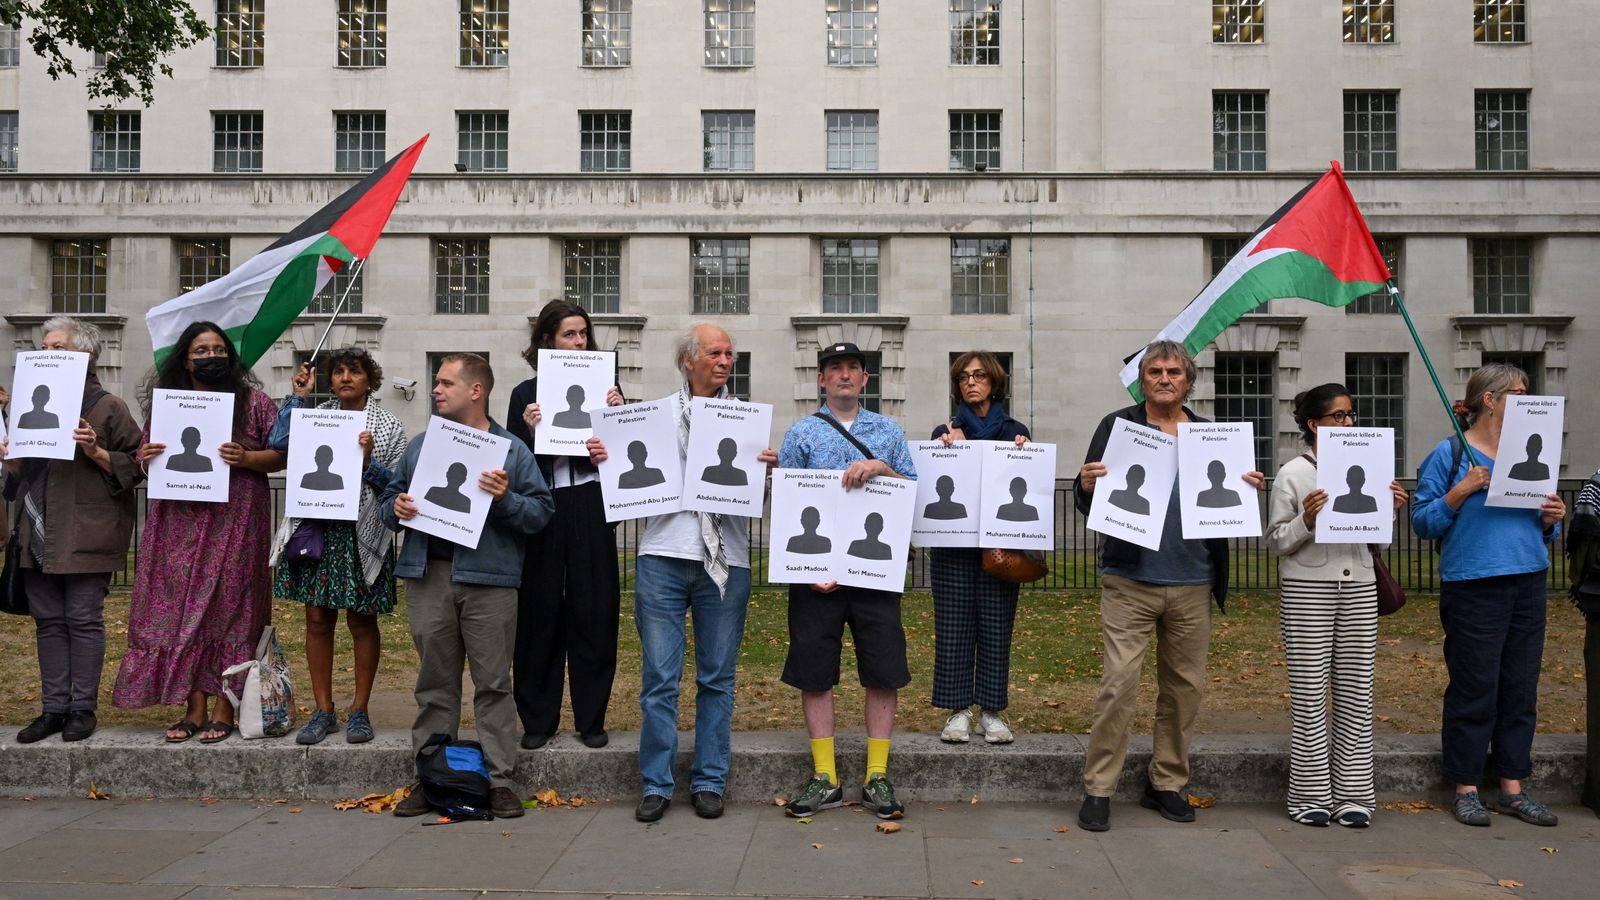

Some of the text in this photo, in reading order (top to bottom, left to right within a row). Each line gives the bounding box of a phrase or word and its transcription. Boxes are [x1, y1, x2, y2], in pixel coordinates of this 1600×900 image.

[602, 409, 633, 419] Journalist
[634, 406, 651, 414] killed
[704, 402, 734, 411] Journalist
[735, 405, 752, 413] killed
[618, 416, 647, 424] Palestine
[717, 412, 745, 420] Palestine
[441, 423, 471, 438] Journalist
[472, 431, 489, 443] killed
[1124, 425, 1151, 439] Journalist
[1151, 434, 1167, 444] killed
[452, 435, 481, 449] Palestine
[1133, 438, 1159, 451] Palestine
[882, 481, 899, 489] killed
[865, 487, 892, 496] Palestine
[609, 499, 647, 510] Mohammed
[661, 495, 681, 503] Jasser
[696, 494, 750, 505] Abdelhalim Awad
[417, 511, 438, 522] hammad
[1104, 515, 1147, 535] Ahmed Shahab
[847, 568, 887, 579] Sari Mansour
